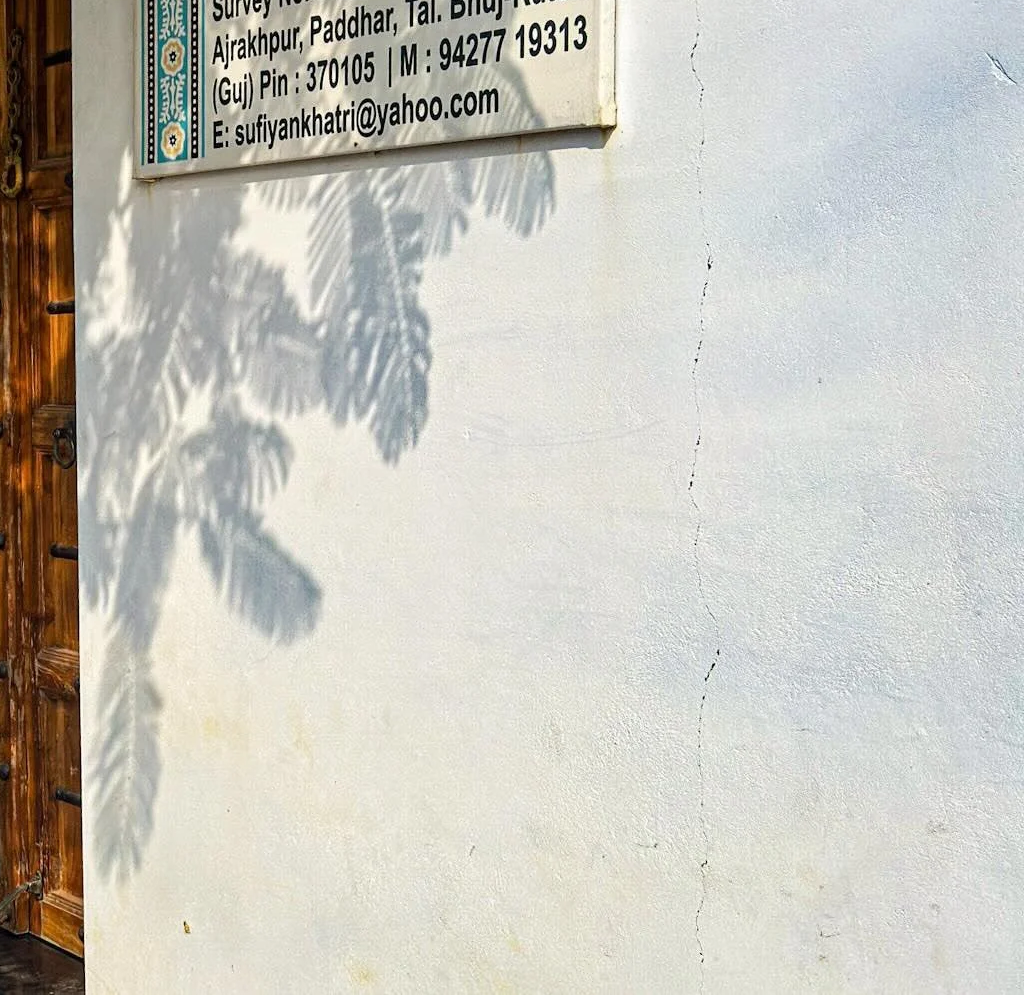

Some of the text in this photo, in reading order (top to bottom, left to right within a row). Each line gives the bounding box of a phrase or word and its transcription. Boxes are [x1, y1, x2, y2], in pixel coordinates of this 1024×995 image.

[212, 25, 304, 67] Ajrakhpur,
[310, 5, 399, 46] Paddhar,
[212, 74, 254, 111] (Guj)
[260, 69, 288, 98] Pin
[306, 52, 375, 91] 370105
[400, 46, 420, 79] M
[439, 28, 504, 71] 94277
[515, 15, 588, 57] 19313
[212, 85, 500, 149] E: sufiyankhatri@yahoo.com
